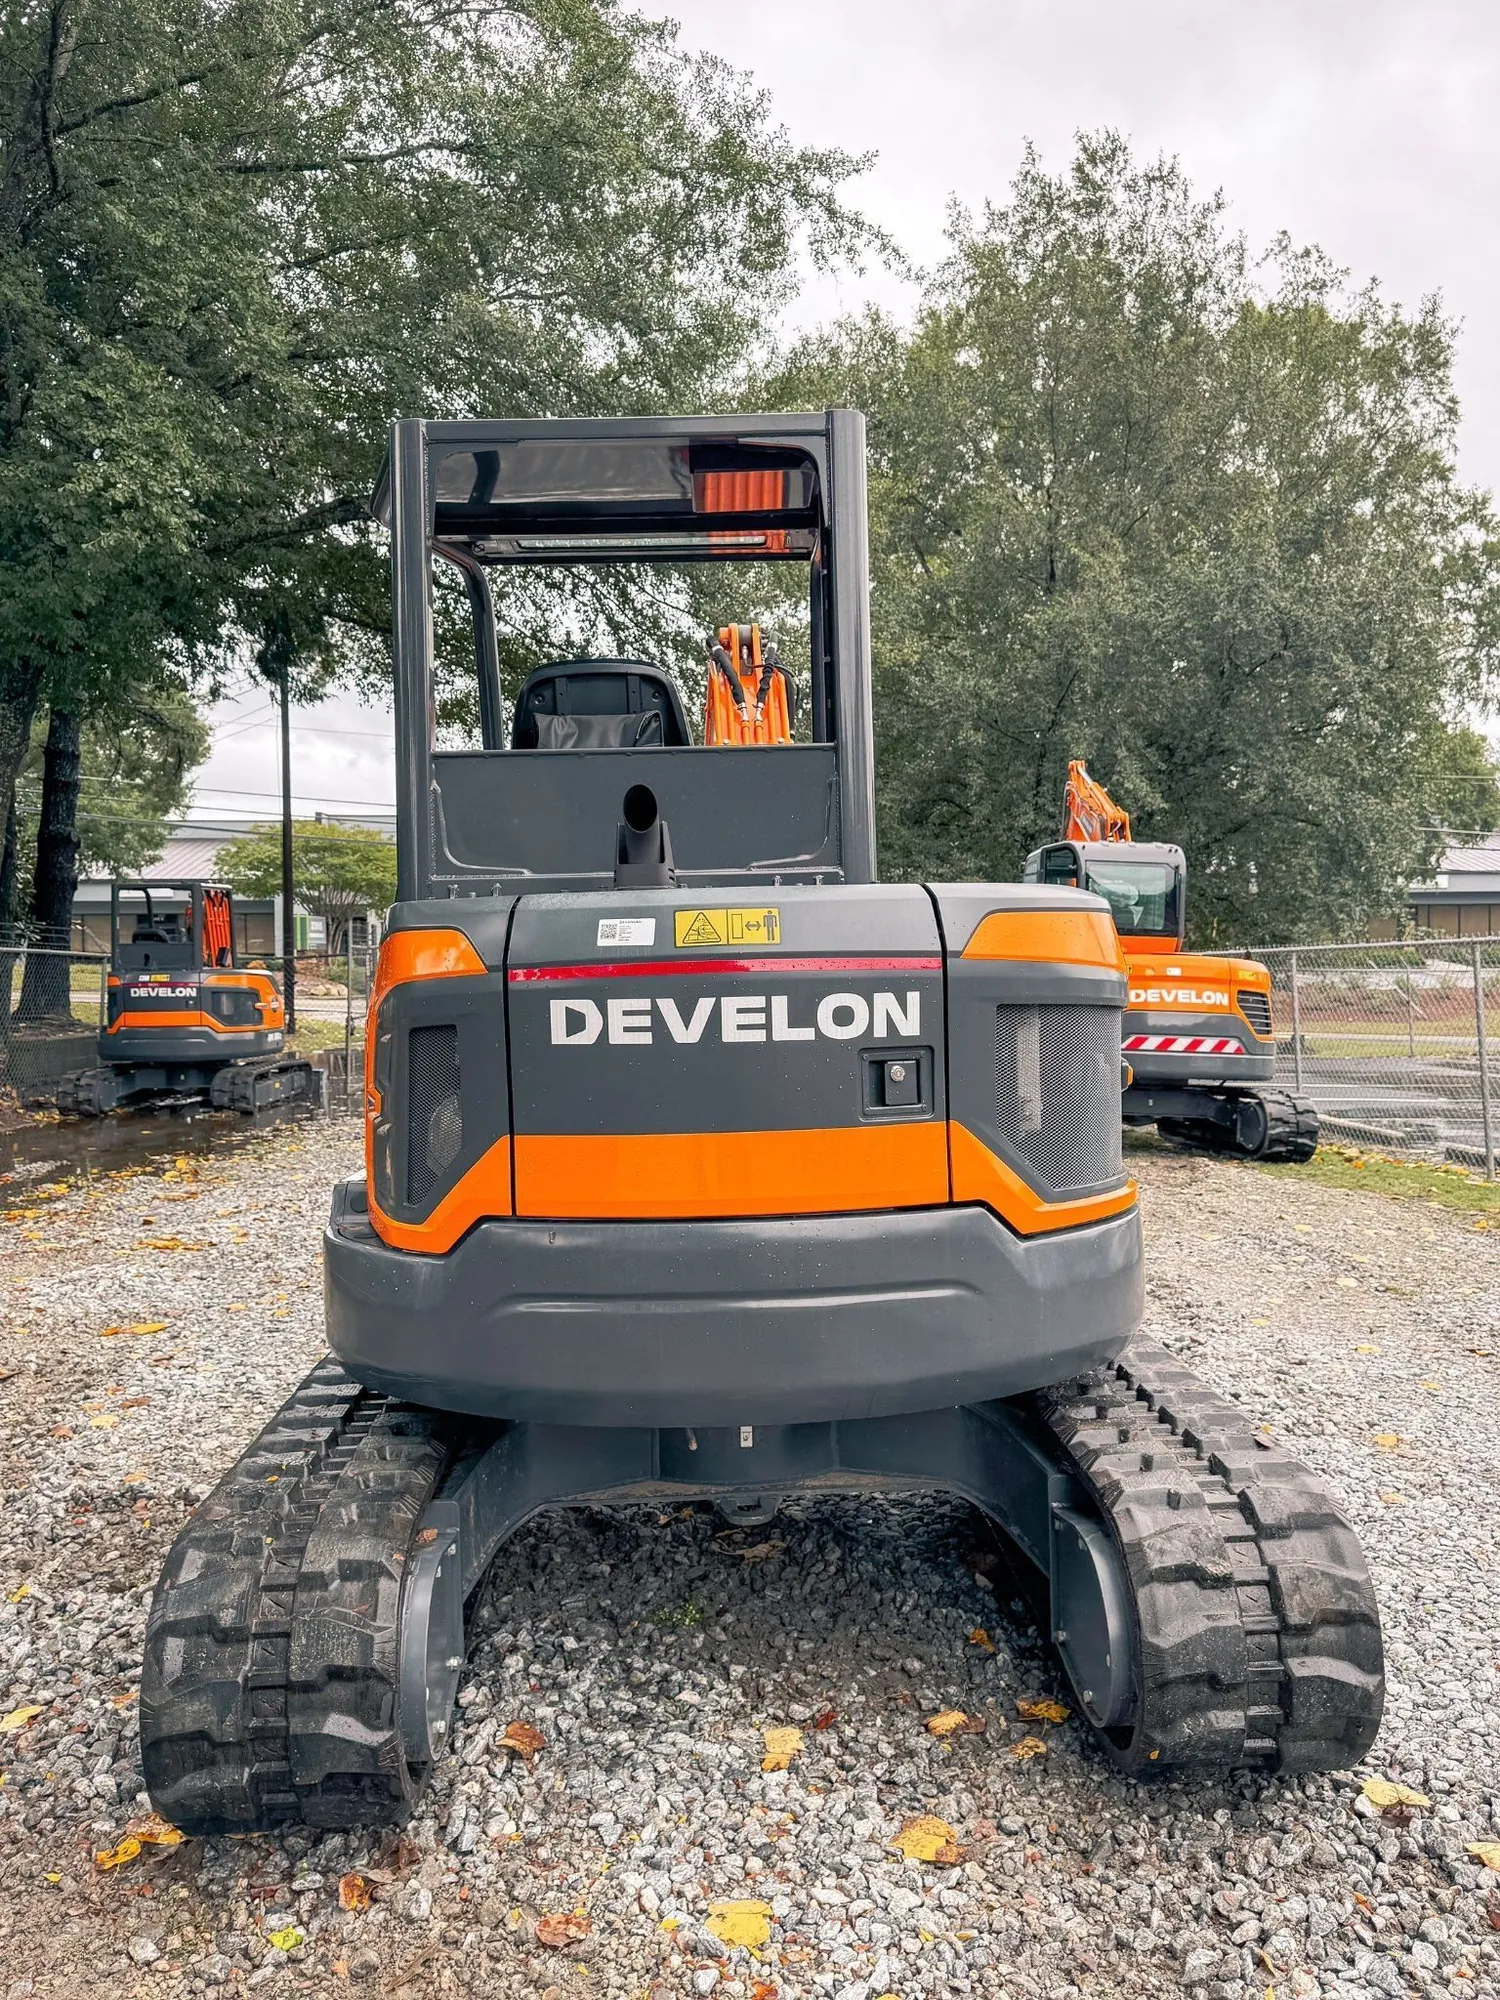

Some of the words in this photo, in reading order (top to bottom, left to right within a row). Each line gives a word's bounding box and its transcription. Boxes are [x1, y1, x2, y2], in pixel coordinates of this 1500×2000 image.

[130, 987, 197, 997] DEVELON
[1130, 989, 1228, 1006] DEVELON
[549, 991, 920, 1045] DEVELON
